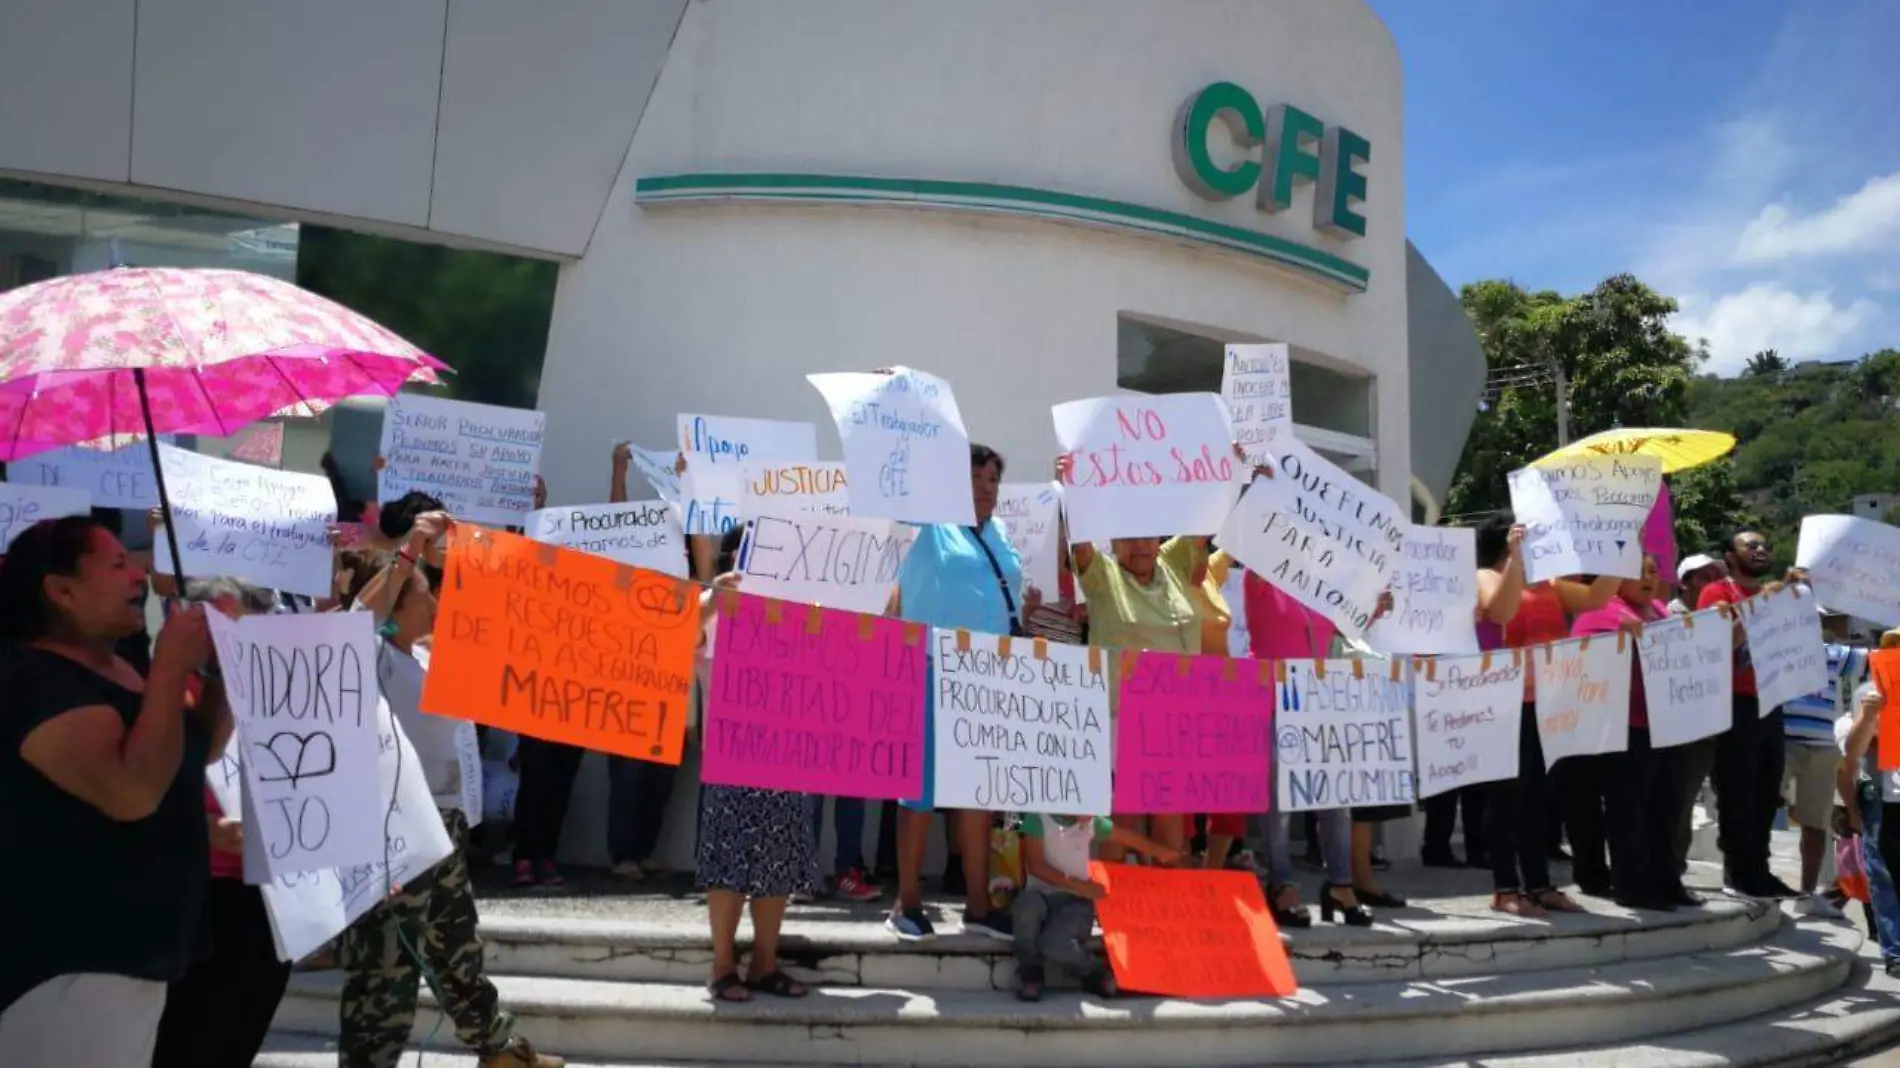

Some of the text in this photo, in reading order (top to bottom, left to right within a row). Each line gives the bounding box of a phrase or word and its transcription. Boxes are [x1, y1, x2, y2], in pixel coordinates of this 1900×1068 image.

[1173, 81, 1371, 240] CFE
[1116, 405, 1167, 441] NO
[570, 504, 670, 533] Procurador
[451, 610, 493, 646] DE
[507, 626, 543, 663] LA
[504, 590, 658, 662] RESPUESTA
[1041, 657, 1074, 693] QUE
[940, 677, 1102, 733] PROCURADURÍA
[953, 716, 1098, 762] CUMPLA CON LA
[973, 755, 1082, 807] JUSTICIA
[1289, 768, 1331, 808] NO
